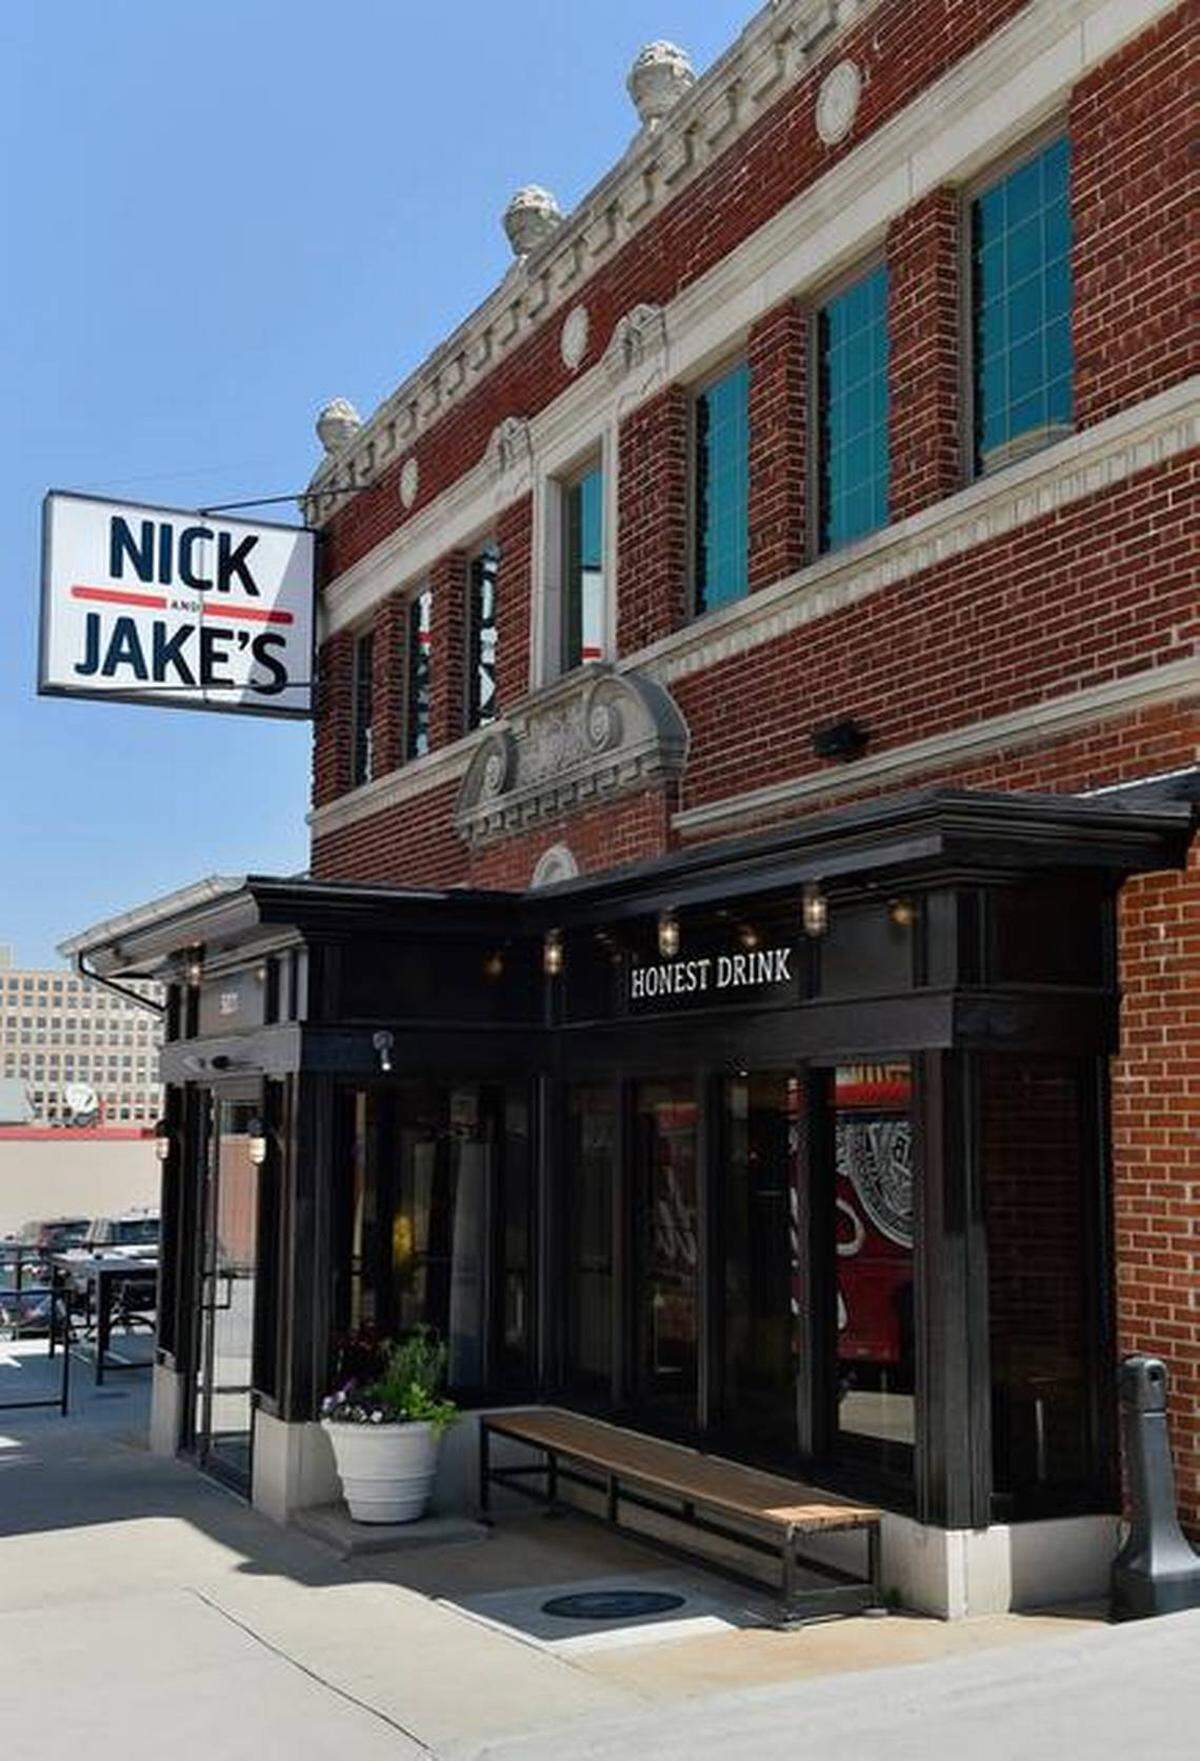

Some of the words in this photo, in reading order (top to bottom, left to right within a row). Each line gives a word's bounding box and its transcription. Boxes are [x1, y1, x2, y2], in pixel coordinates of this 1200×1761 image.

[110, 516, 260, 596] NICK
[170, 600, 202, 613] AND
[74, 613, 288, 695] JAKE'S
[631, 959, 711, 998] HONEST
[717, 948, 791, 987] DRINK
